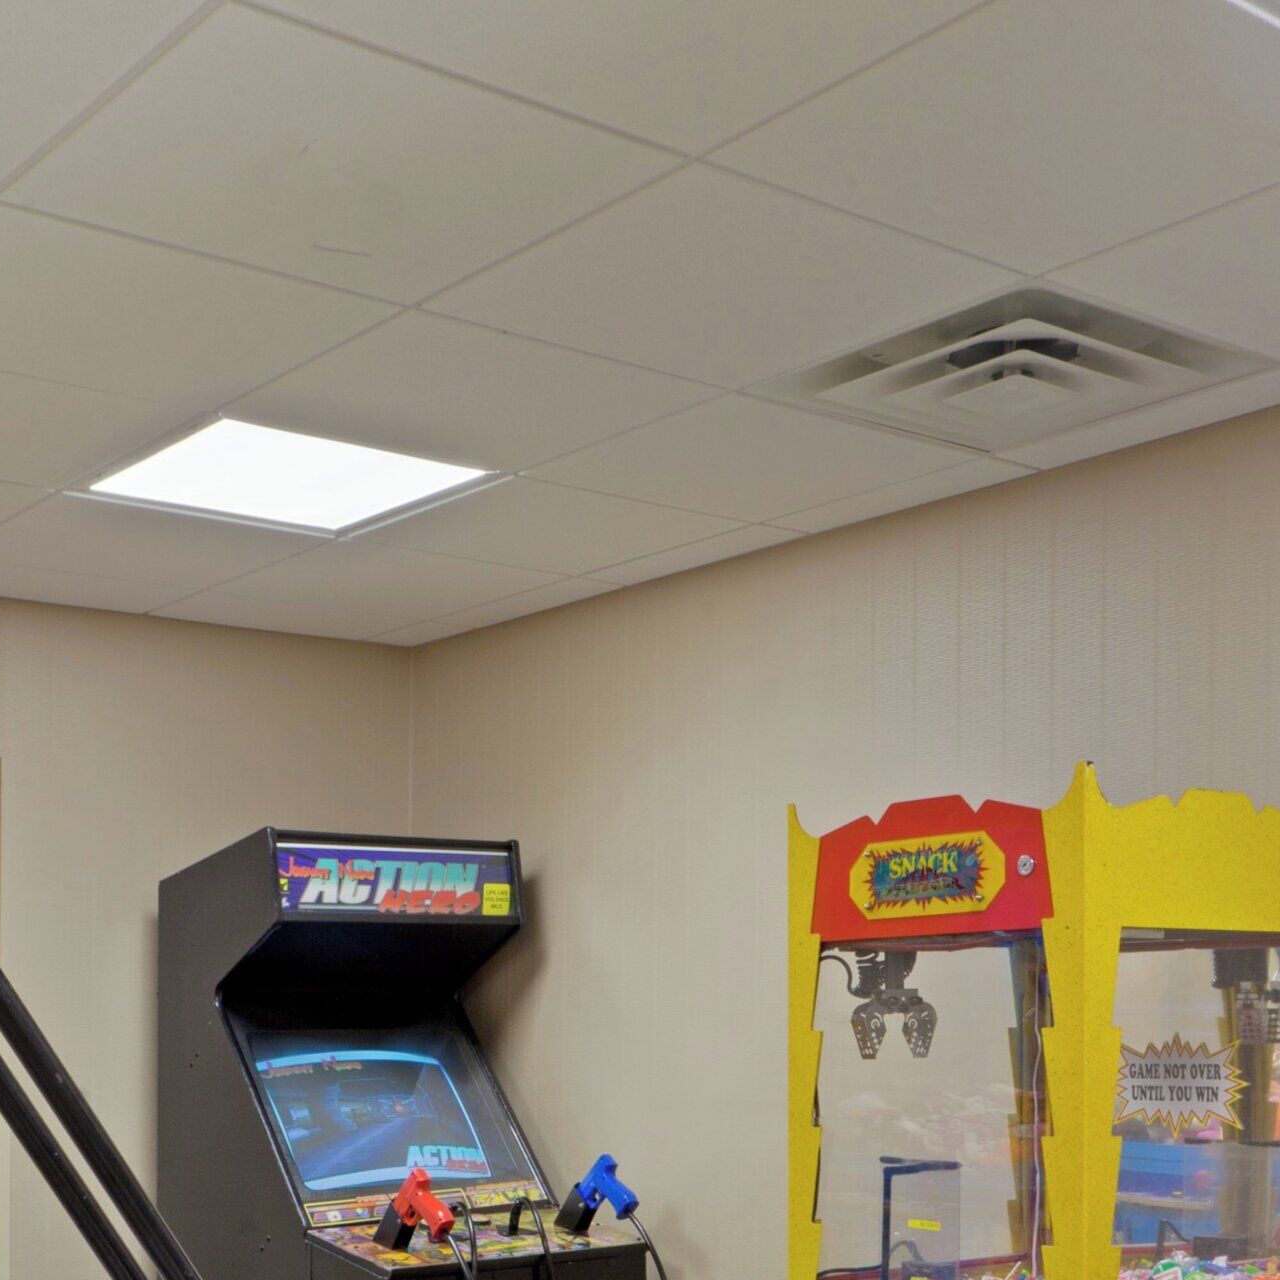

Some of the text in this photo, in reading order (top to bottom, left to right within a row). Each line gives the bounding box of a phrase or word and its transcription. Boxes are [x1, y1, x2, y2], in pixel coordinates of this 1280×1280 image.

[888, 850, 959, 879] SNACK
[299, 857, 480, 905] ACTION
[376, 889, 481, 915] HERO
[1128, 1063, 1222, 1080] GAME NOT OVER
[1131, 1085, 1219, 1103] UNTIL YOU WIN
